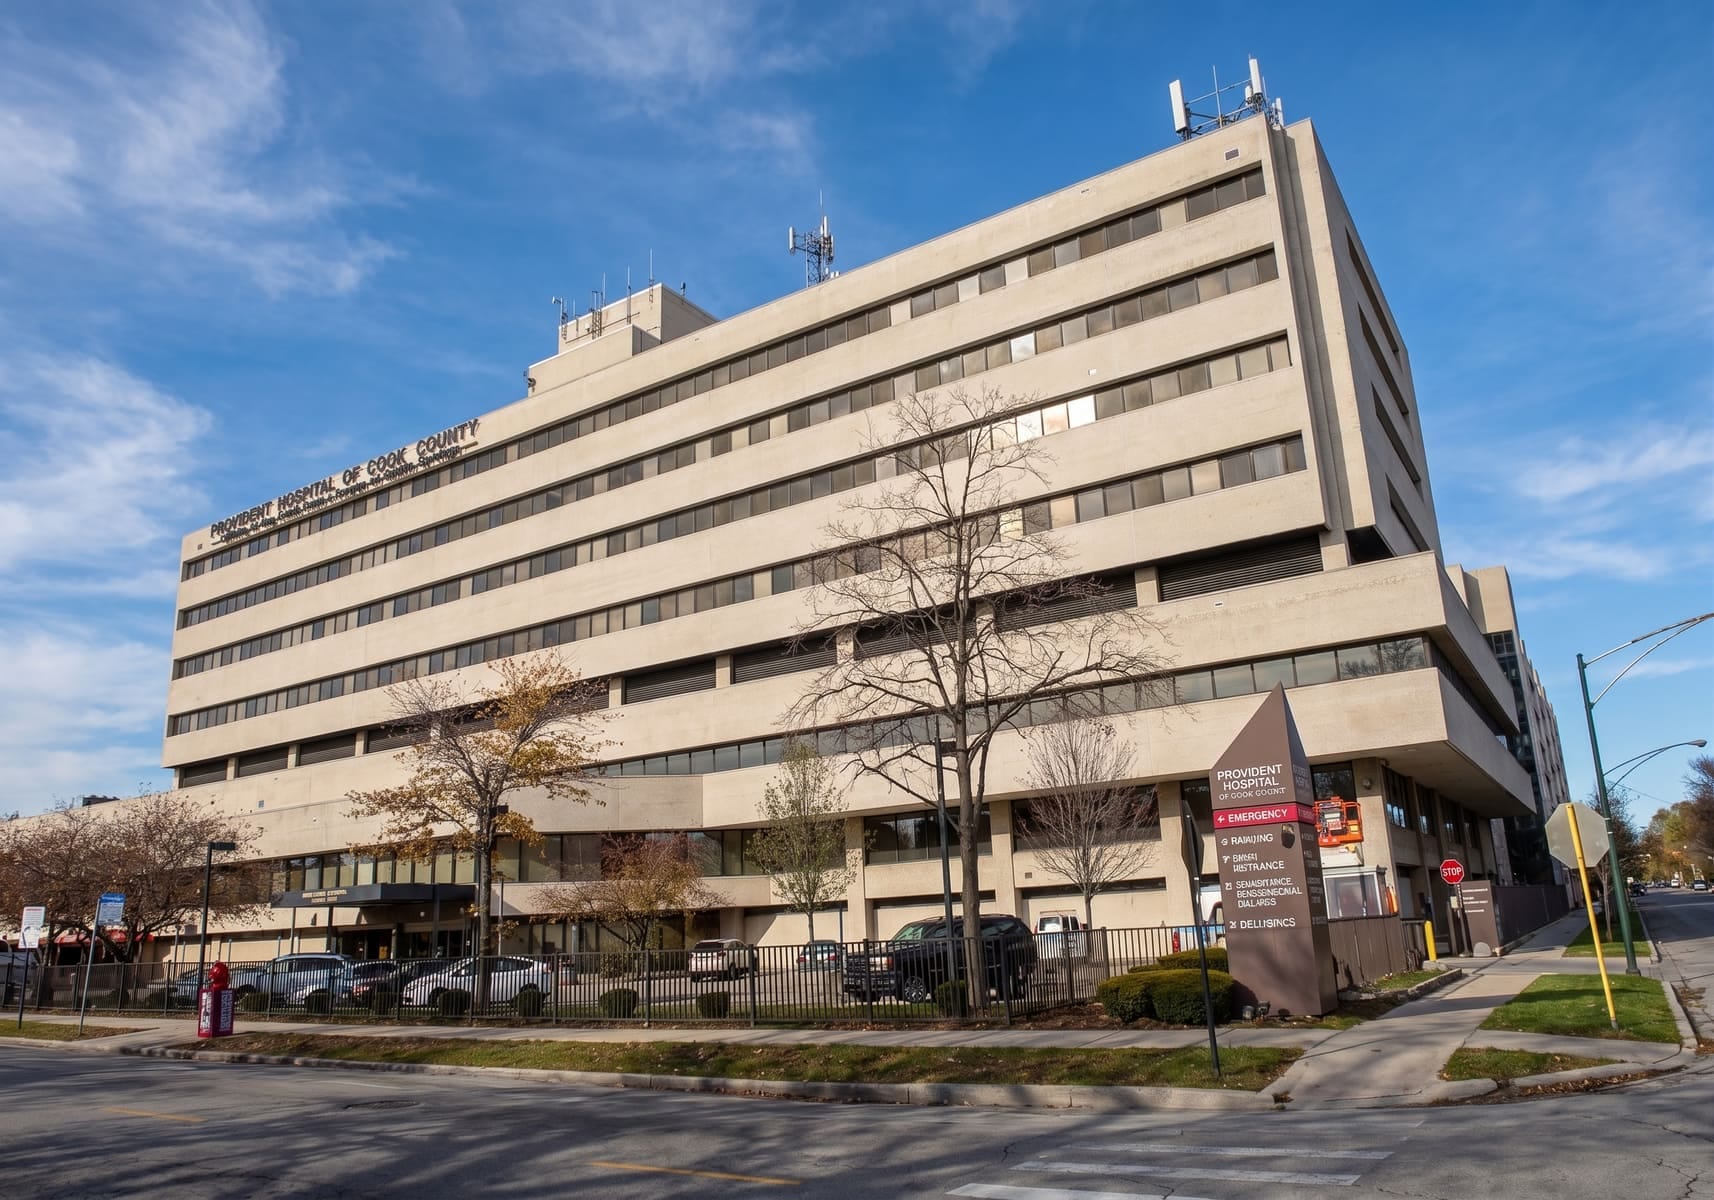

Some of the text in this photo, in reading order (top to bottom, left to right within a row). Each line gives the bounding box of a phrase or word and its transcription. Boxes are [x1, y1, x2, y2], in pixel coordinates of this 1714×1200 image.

[210, 501, 274, 538] PROVIDENT
[278, 476, 336, 511] HOSPITAL
[342, 465, 363, 486] OF
[367, 447, 408, 476] COOK
[416, 418, 480, 457] COUNTY
[1217, 764, 1282, 781] PROVIDENT
[1223, 776, 1279, 791] HOSPITAL
[1218, 793, 1229, 801] OF
[1228, 808, 1288, 823] EMERGENCY
[1442, 866, 1462, 877] STOP
